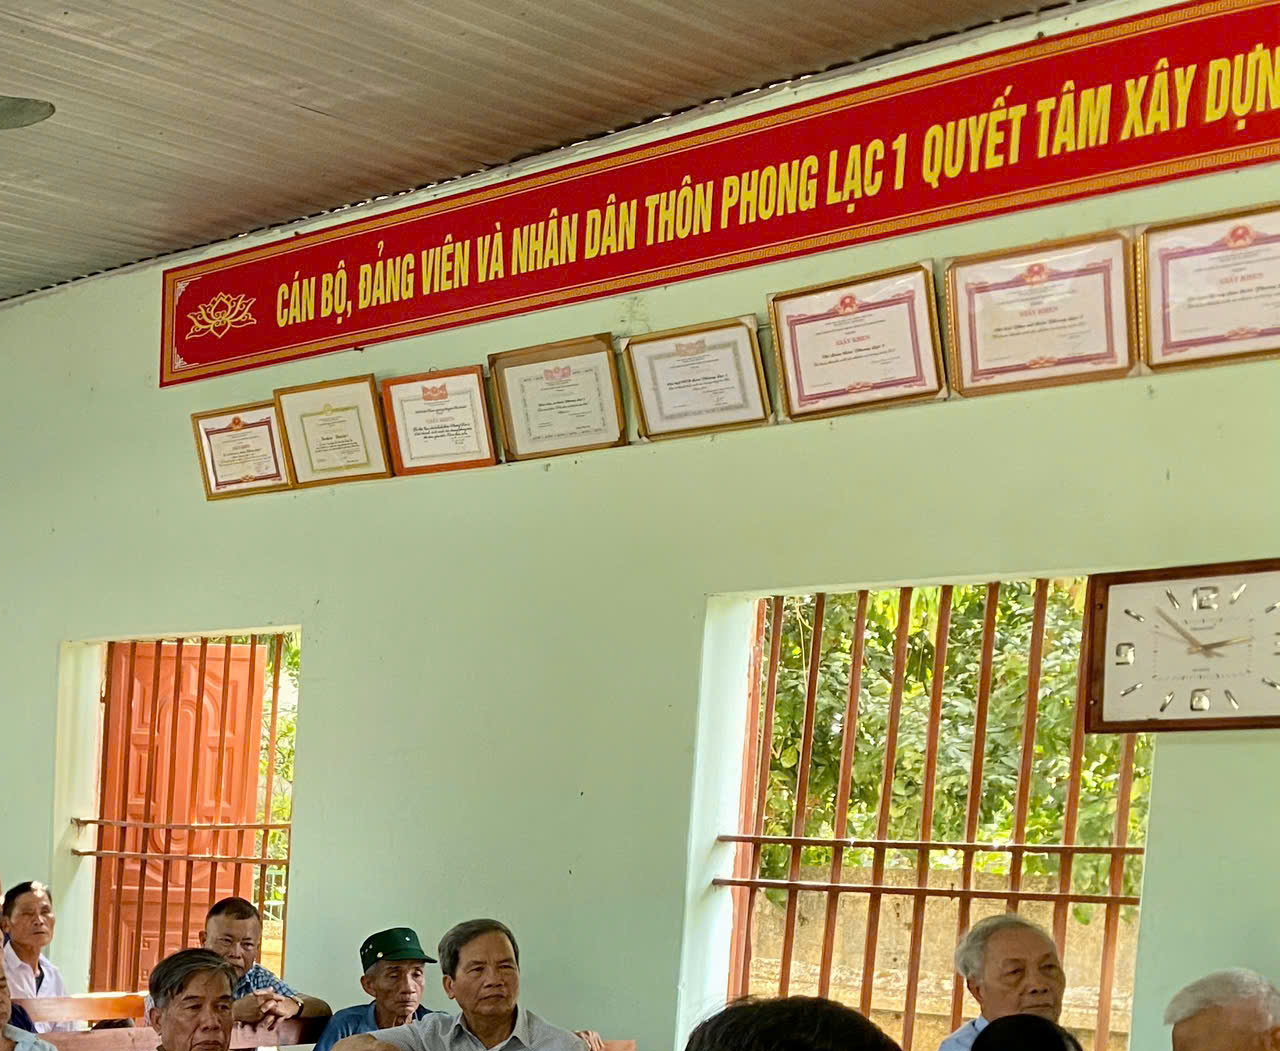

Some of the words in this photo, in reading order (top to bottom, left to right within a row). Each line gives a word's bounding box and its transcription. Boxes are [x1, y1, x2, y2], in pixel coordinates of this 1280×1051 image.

[276, 271, 316, 328] CÁN
[320, 260, 352, 324] BỘ,
[358, 240, 415, 310] ĐẢNG
[421, 234, 471, 296] VIÊN
[477, 222, 505, 283] VÀ
[511, 207, 579, 276] NHÂN
[584, 193, 638, 260] DÂN
[645, 175, 714, 246] THÔN
[720, 155, 819, 229] PHONG
[826, 138, 885, 214] LẠC
[891, 133, 907, 190] 1
[922, 85, 1027, 189] QUYẾT
[1036, 79, 1113, 158] TÂM
[1119, 57, 1198, 141] XÂY
[1204, 43, 1280, 131] DỰN
